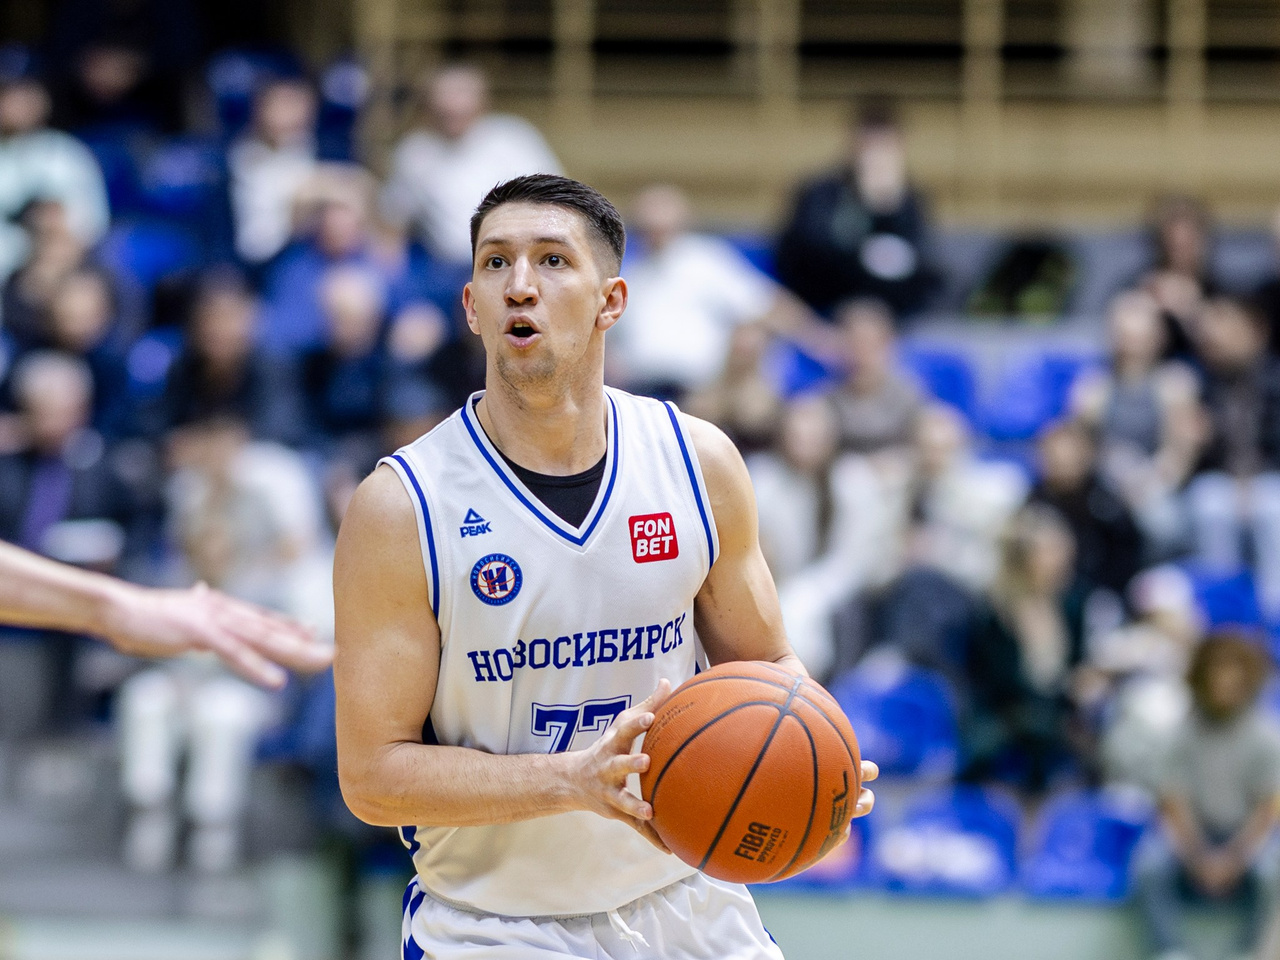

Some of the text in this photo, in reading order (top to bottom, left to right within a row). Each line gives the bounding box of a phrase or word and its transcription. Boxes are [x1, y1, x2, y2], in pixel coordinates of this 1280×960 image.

[459, 521, 493, 539] PEAK
[633, 517, 671, 538] FON
[635, 535, 674, 558] BET
[472, 554, 518, 580] НОВОСИБИРСК
[467, 612, 687, 682] НОВОСИБИРСК
[733, 821, 772, 861] FIBA
